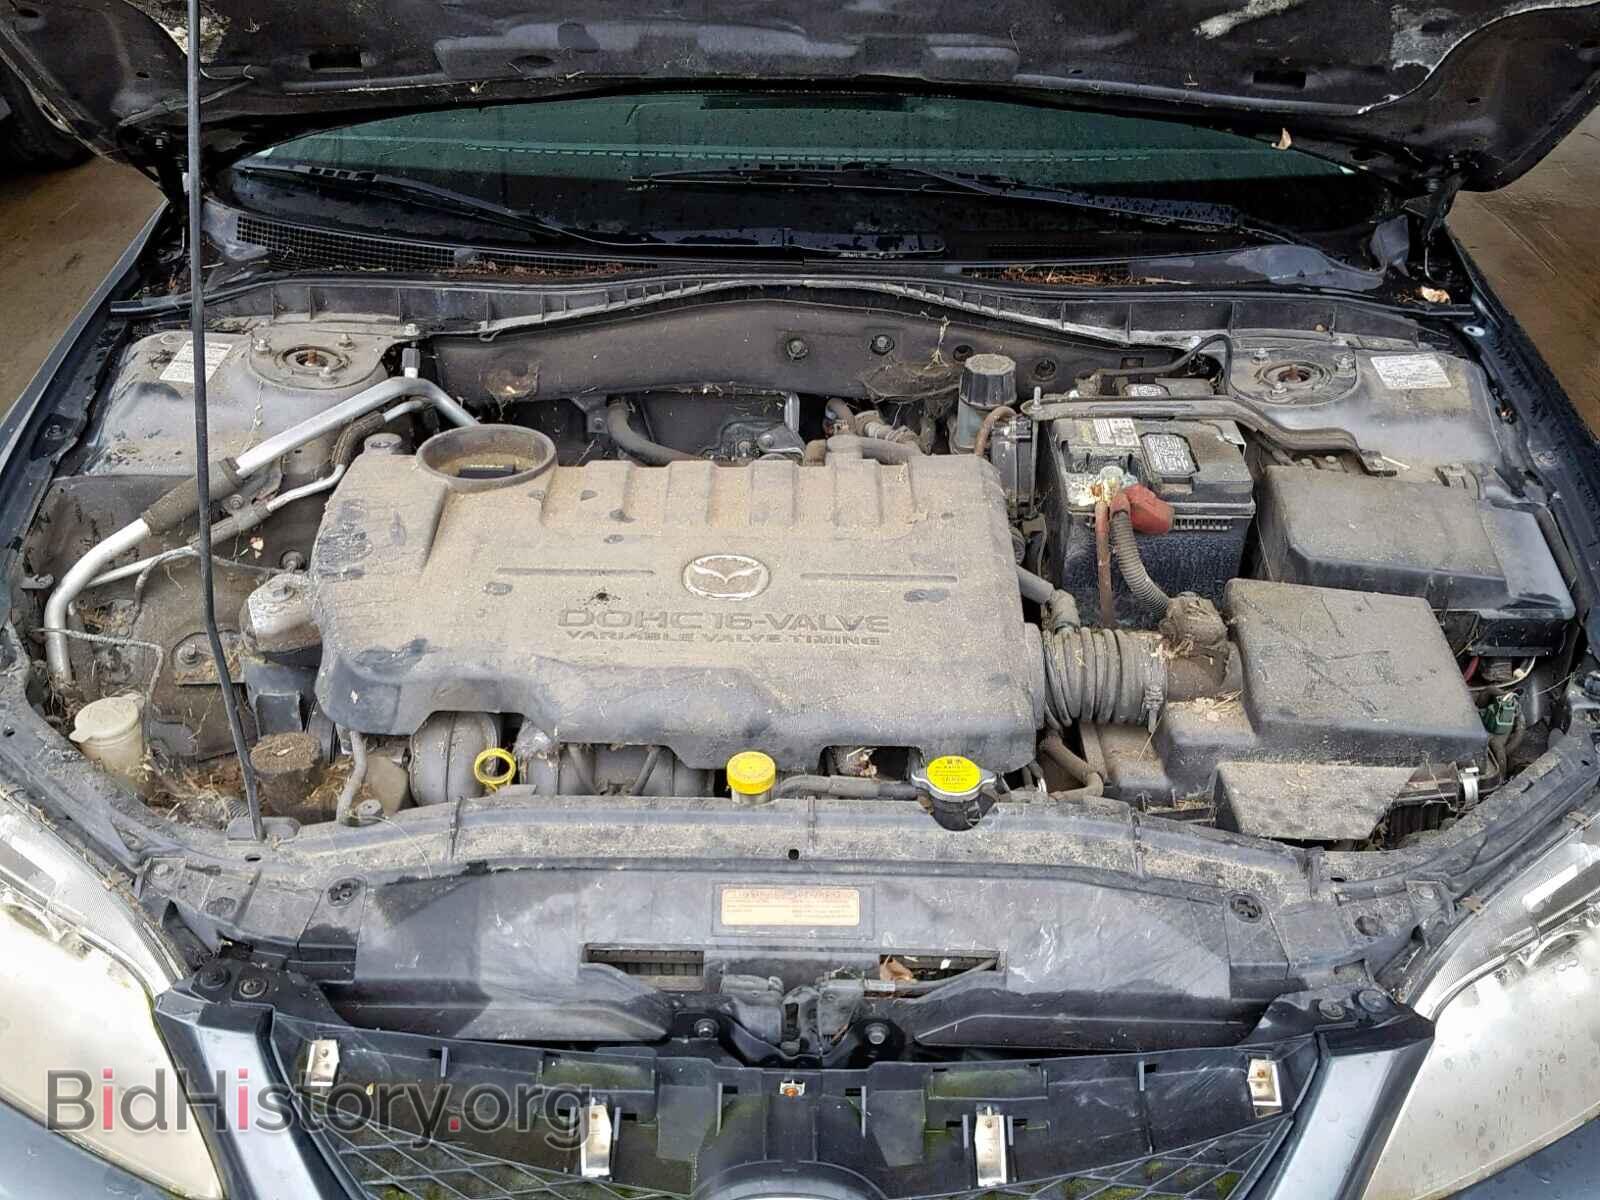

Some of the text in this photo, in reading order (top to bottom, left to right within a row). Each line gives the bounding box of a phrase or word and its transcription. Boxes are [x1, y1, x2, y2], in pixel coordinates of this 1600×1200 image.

[558, 609, 890, 633] DOHC 16-VALVE
[566, 630, 881, 646] VARIABLE VALVE TIMING
